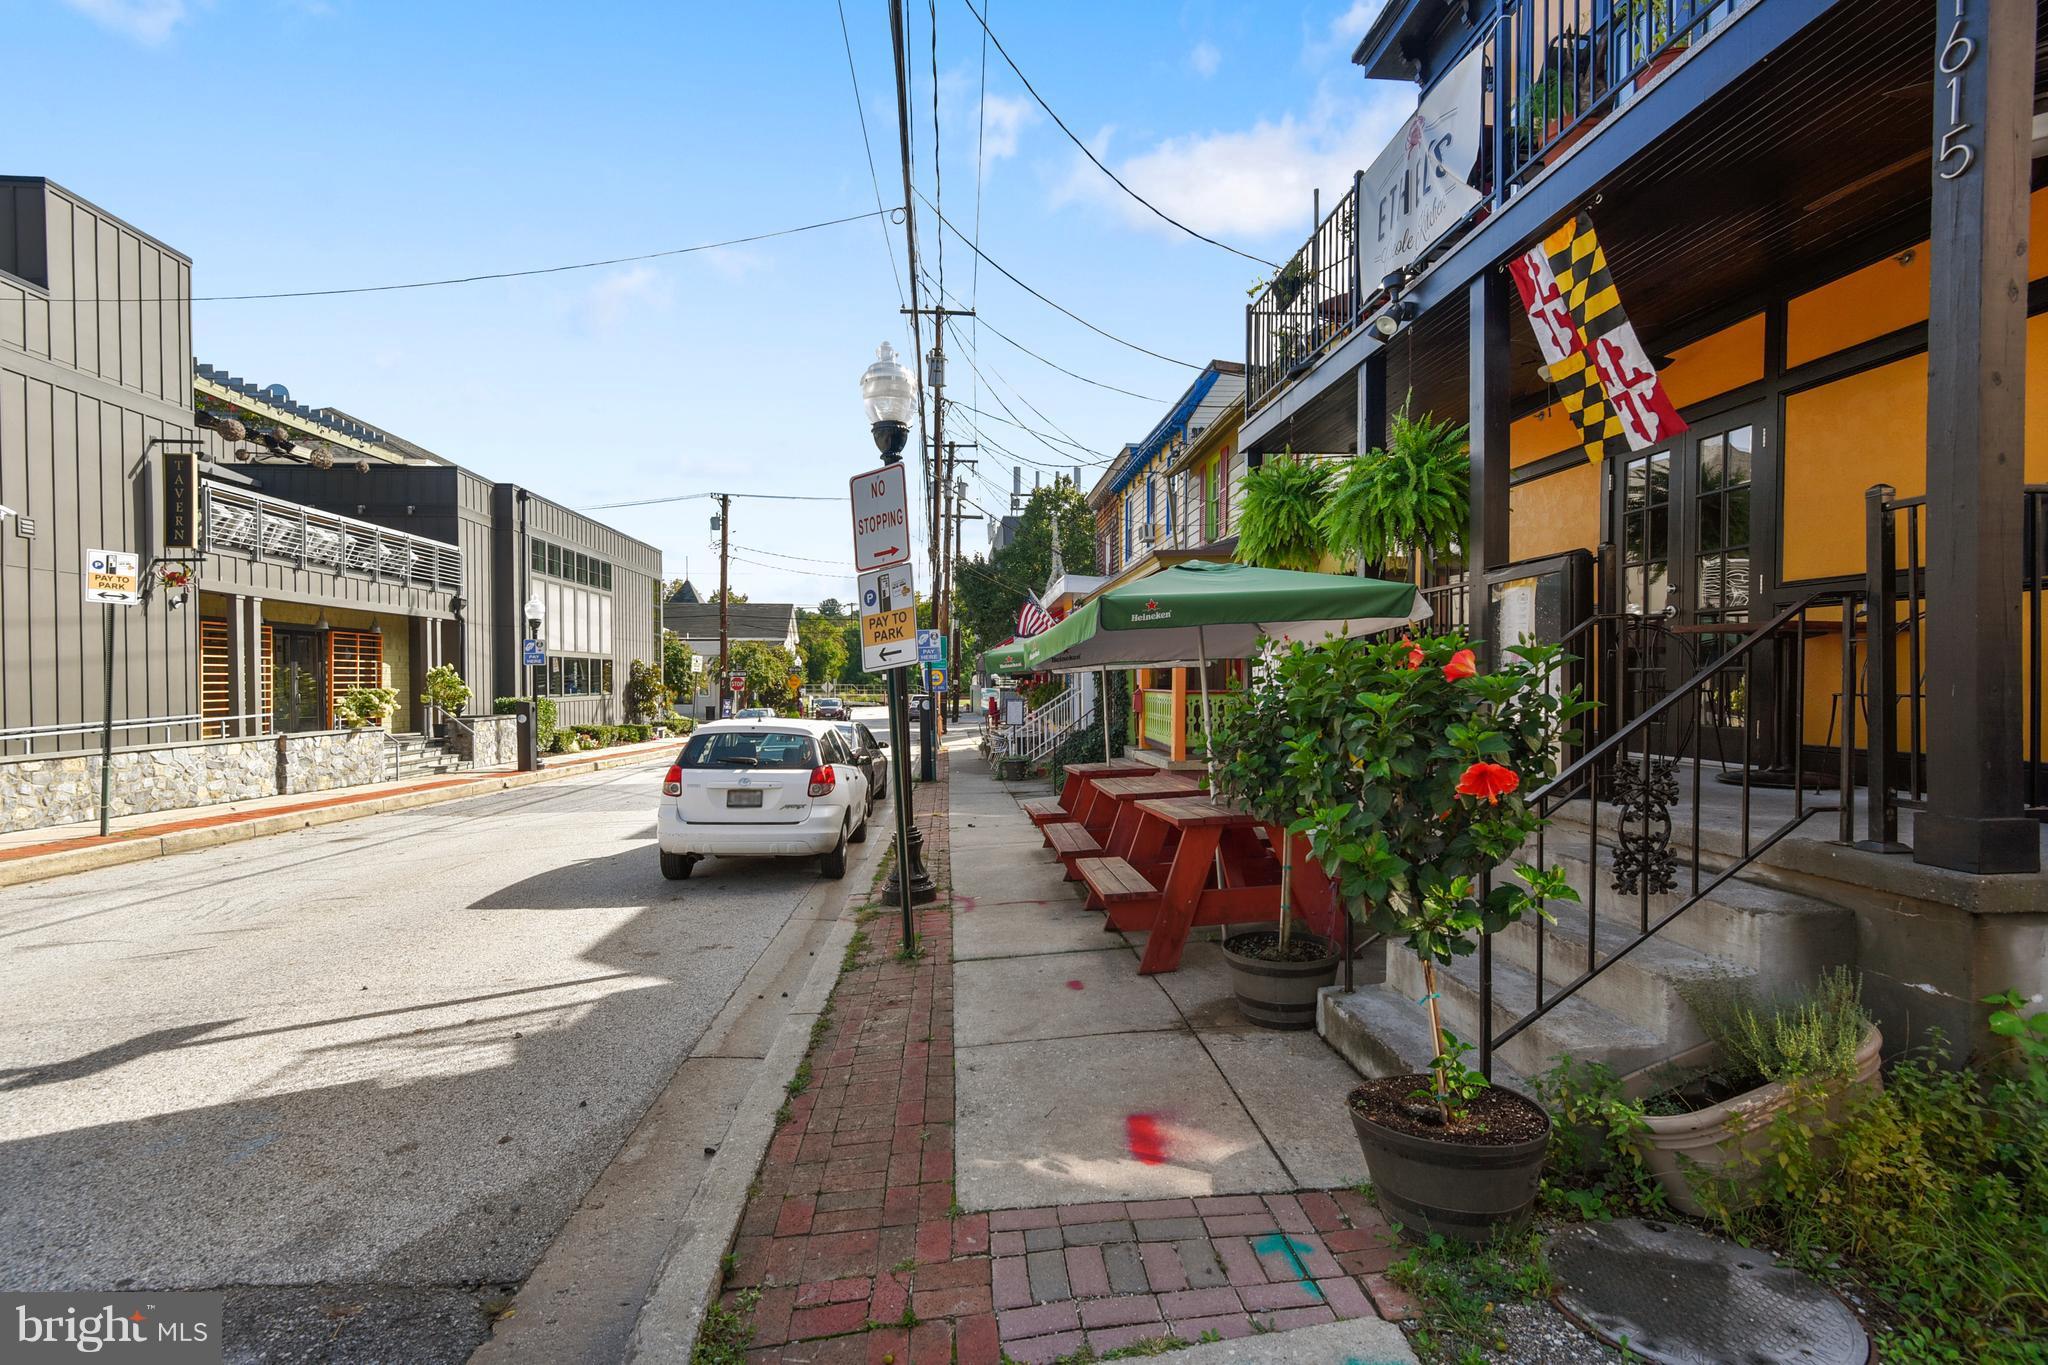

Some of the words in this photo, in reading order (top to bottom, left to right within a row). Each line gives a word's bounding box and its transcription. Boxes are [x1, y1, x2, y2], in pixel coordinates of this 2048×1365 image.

[871, 479, 885, 498] NO
[174, 460, 185, 540] TAVERN
[858, 508, 903, 535] STOPPING
[95, 574, 113, 582] PAY
[116, 576, 130, 584] TO
[98, 582, 126, 590] PARK
[868, 614, 889, 630] PAY
[892, 611, 907, 625] TO
[1131, 611, 1171, 622] Heineken
[874, 626, 904, 643] PARK
